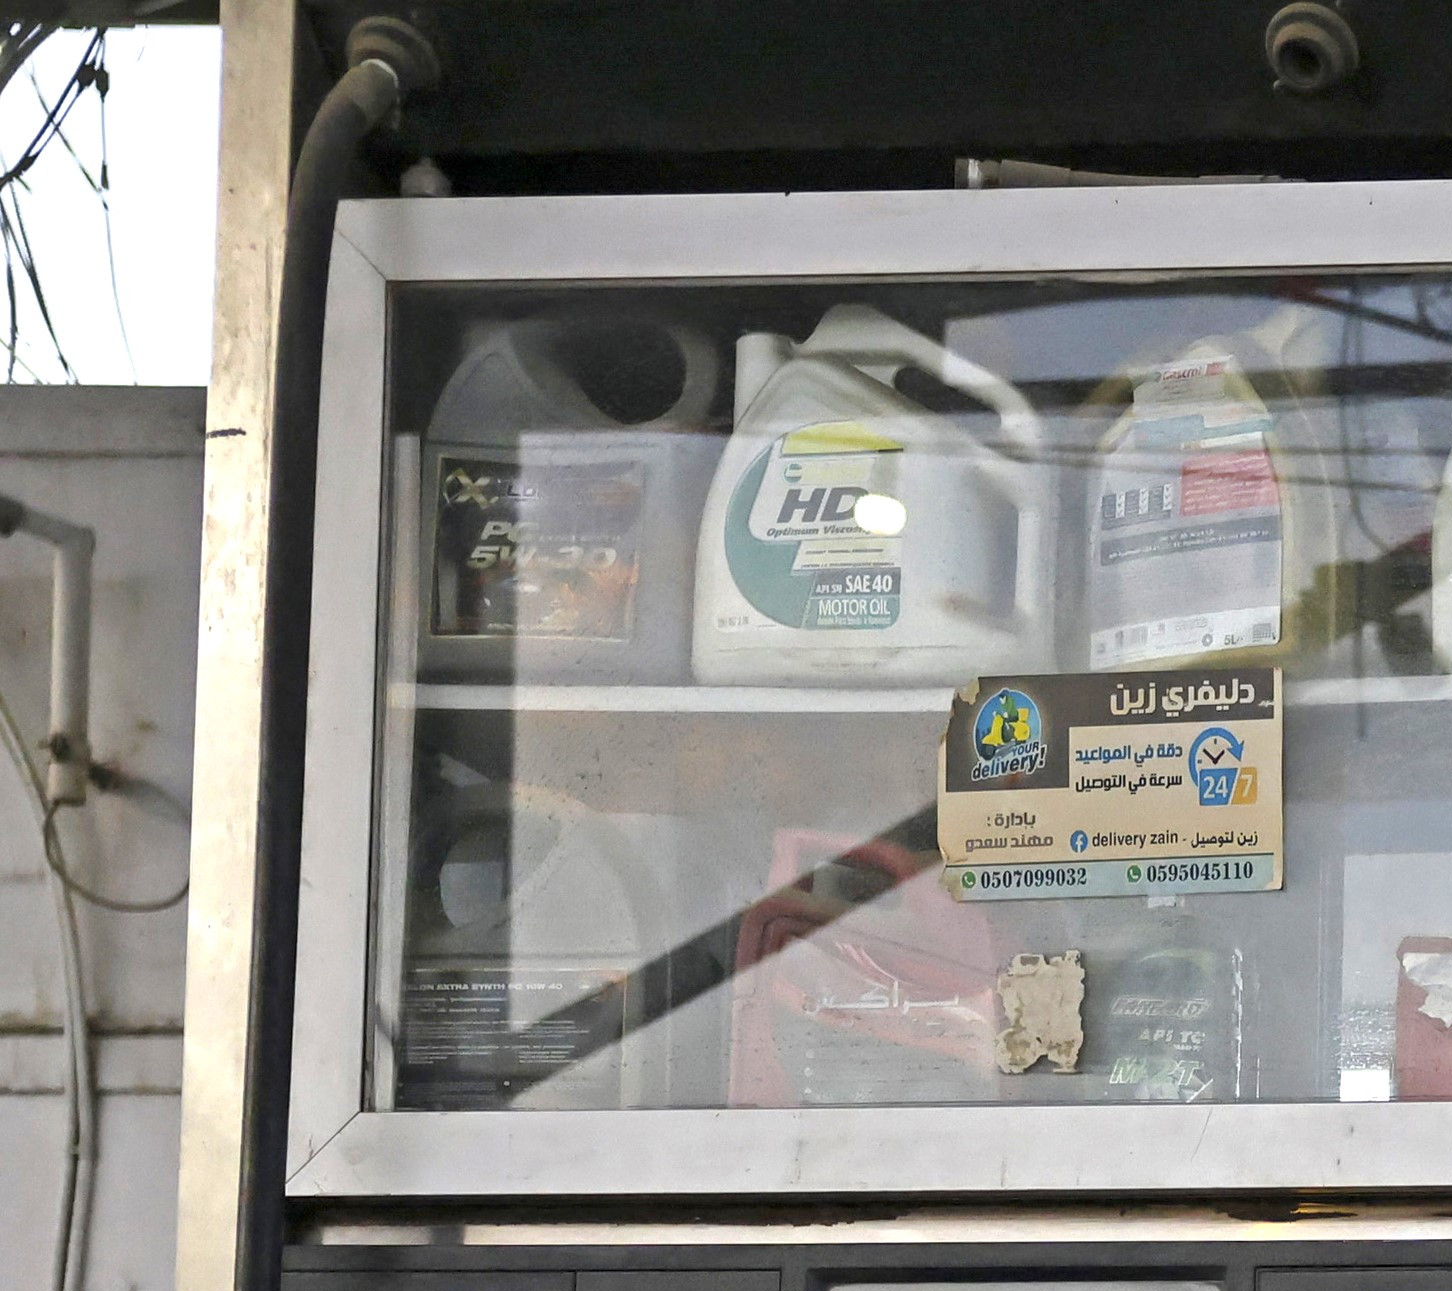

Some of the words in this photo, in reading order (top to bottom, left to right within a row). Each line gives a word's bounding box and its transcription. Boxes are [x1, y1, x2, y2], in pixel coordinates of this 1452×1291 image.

[845, 575, 871, 593] SAE
[872, 574, 893, 593] 40
[818, 599, 868, 616] MOTOR
[869, 598, 891, 615] OIL
[1109, 682, 1157, 717] زين
[1161, 678, 1256, 717] دليفري
[1011, 740, 1040, 757] YOUR
[1075, 745, 1131, 764] المواعيد
[1134, 745, 1154, 767] في
[1157, 743, 1184, 761] دقة
[971, 744, 1047, 781] delivery!
[1075, 774, 1127, 794] التوصيل
[1129, 775, 1147, 795] في
[1148, 772, 1183, 788] سرعة
[1203, 775, 1229, 800] 24
[1241, 774, 1253, 798] 7
[1092, 830, 1148, 852] delivery
[1150, 830, 1179, 845] zain
[980, 867, 1088, 890] 0507099032
[1146, 860, 1254, 884] 0595045110
